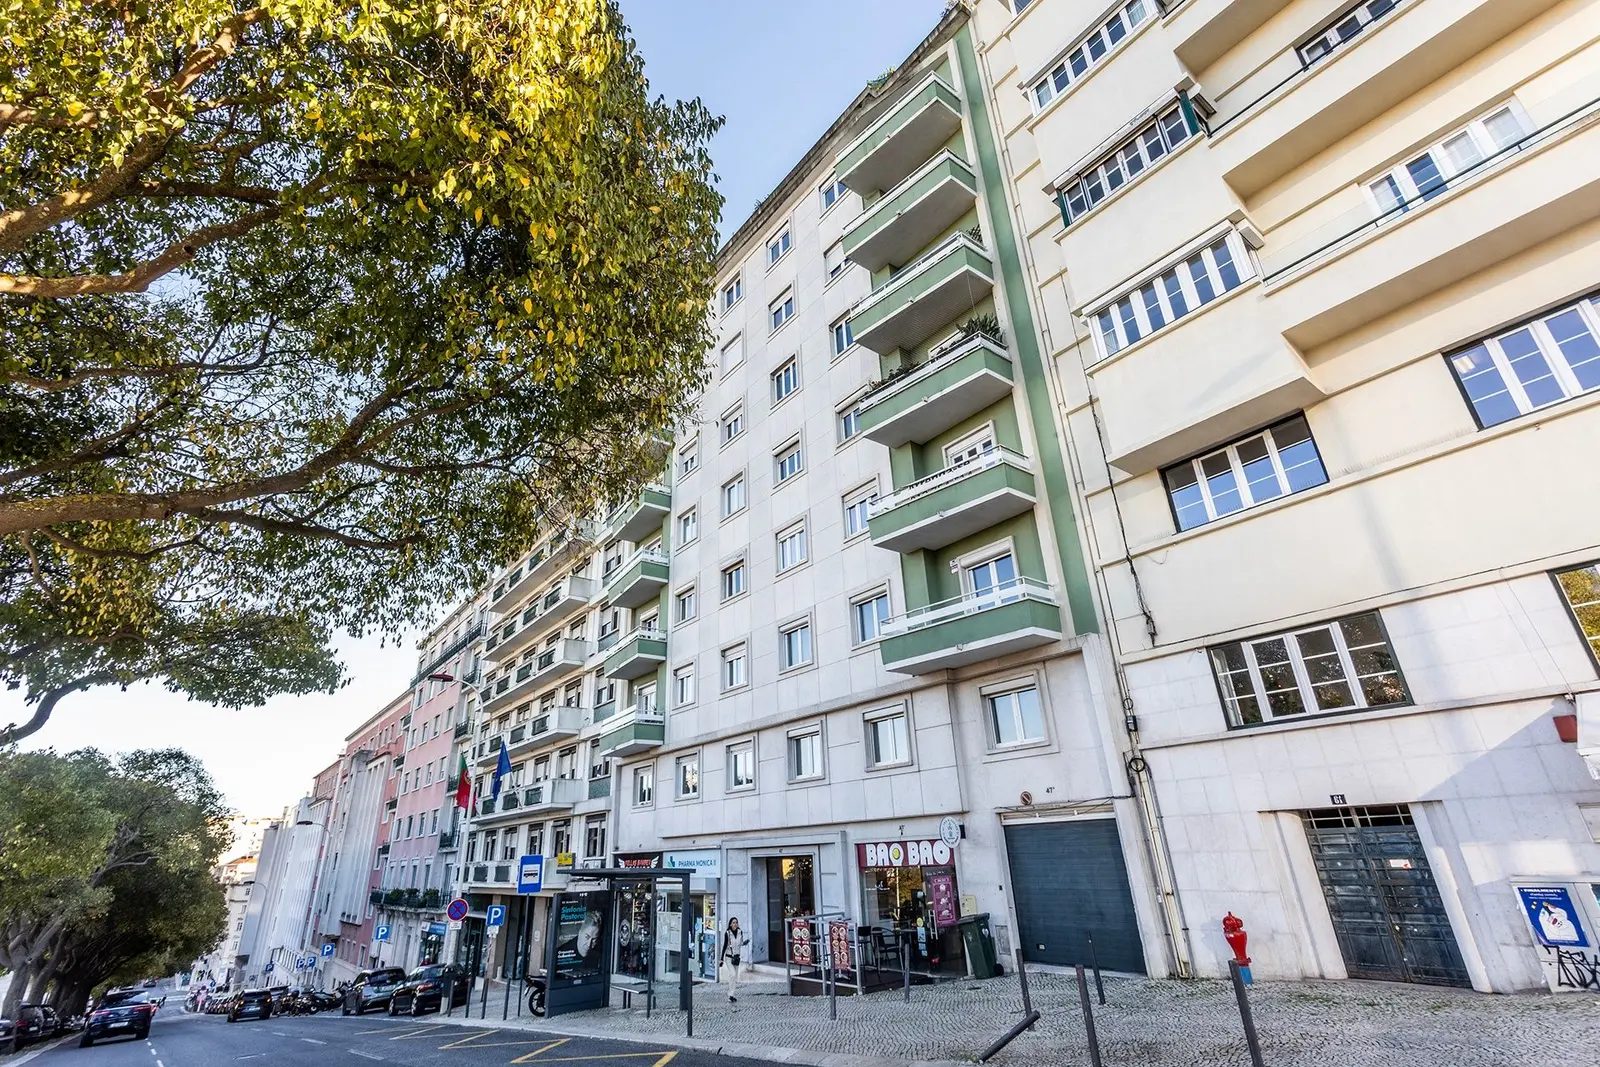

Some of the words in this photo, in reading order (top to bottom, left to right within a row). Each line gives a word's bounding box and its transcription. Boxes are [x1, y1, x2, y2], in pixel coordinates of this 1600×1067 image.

[1333, 795, 1344, 804] 61
[865, 842, 904, 867] BAO
[906, 840, 951, 866] BAO
[561, 905, 587, 914] Sinfonia
[490, 907, 502, 924] P
[560, 912, 587, 921] Pastoral
[377, 927, 388, 938] P
[323, 944, 332, 954] P
[307, 957, 315, 966] P
